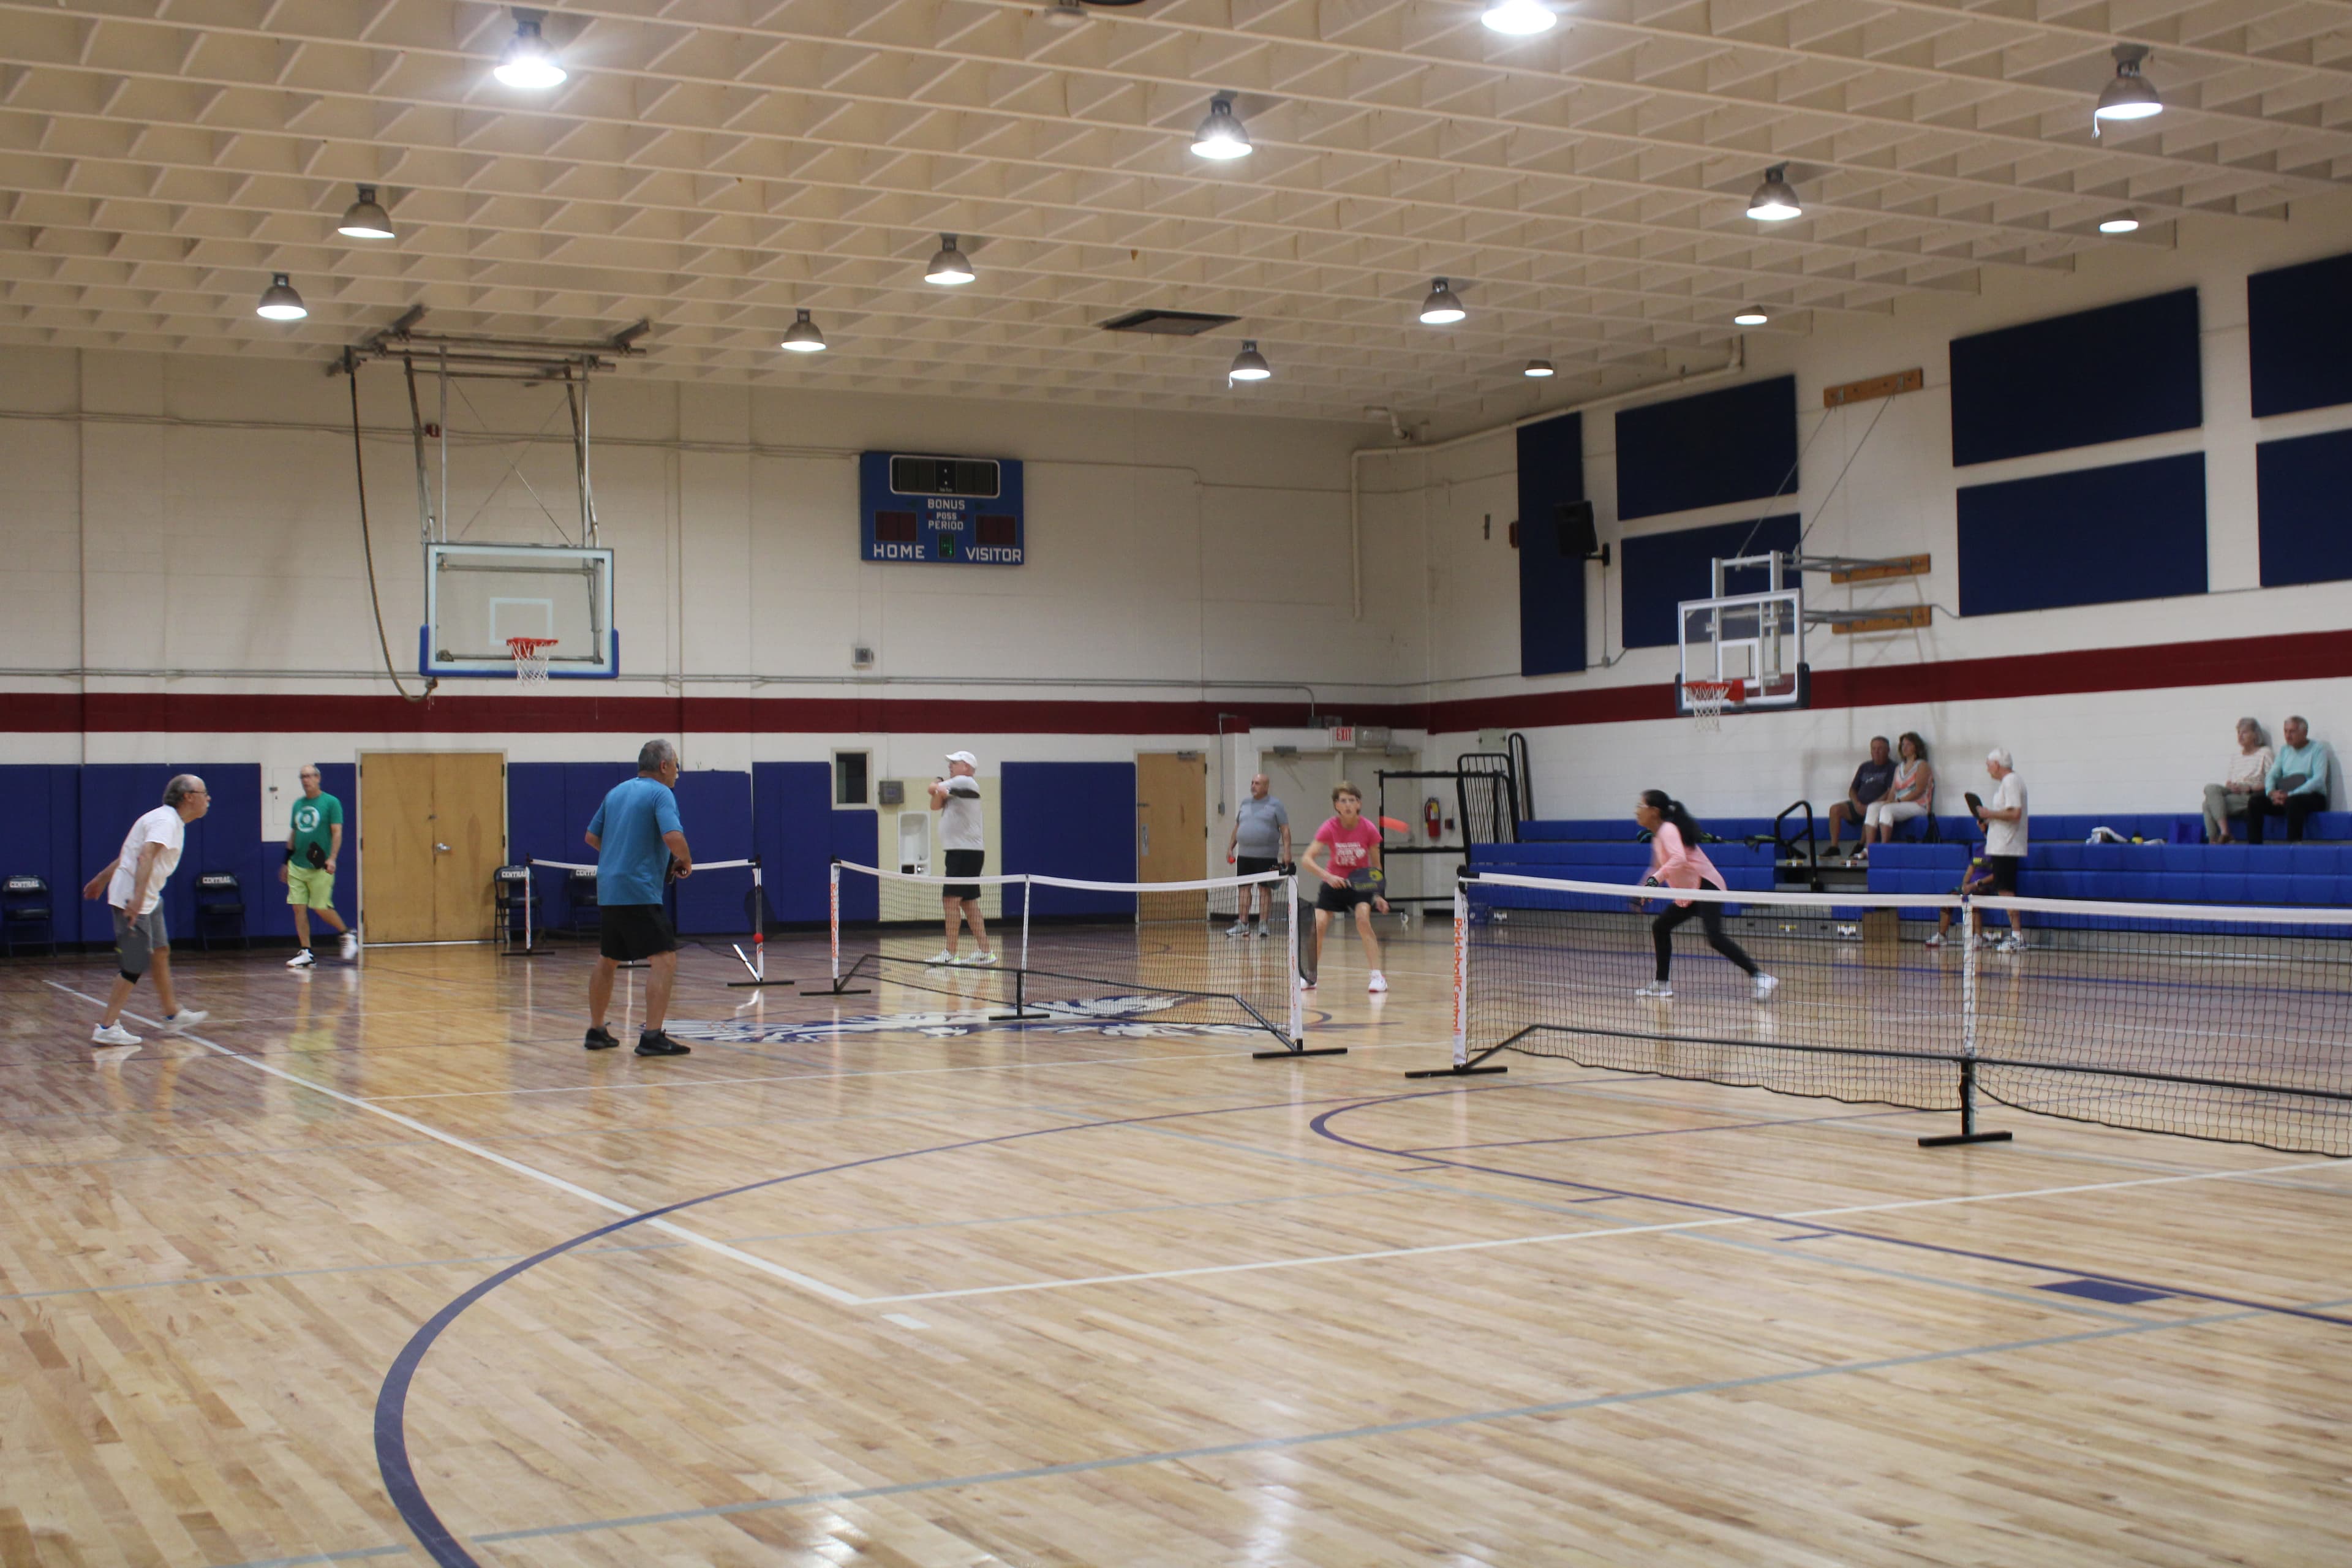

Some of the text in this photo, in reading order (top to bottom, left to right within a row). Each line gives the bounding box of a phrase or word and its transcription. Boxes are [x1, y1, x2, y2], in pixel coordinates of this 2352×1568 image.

[927, 499, 965, 510] BONUS
[936, 511, 957, 520] POSS
[928, 520, 964, 530] PERIOD
[873, 544, 925, 559] HOME
[965, 546, 1022, 562] VISITOR
[1336, 726, 1352, 741] EXIT
